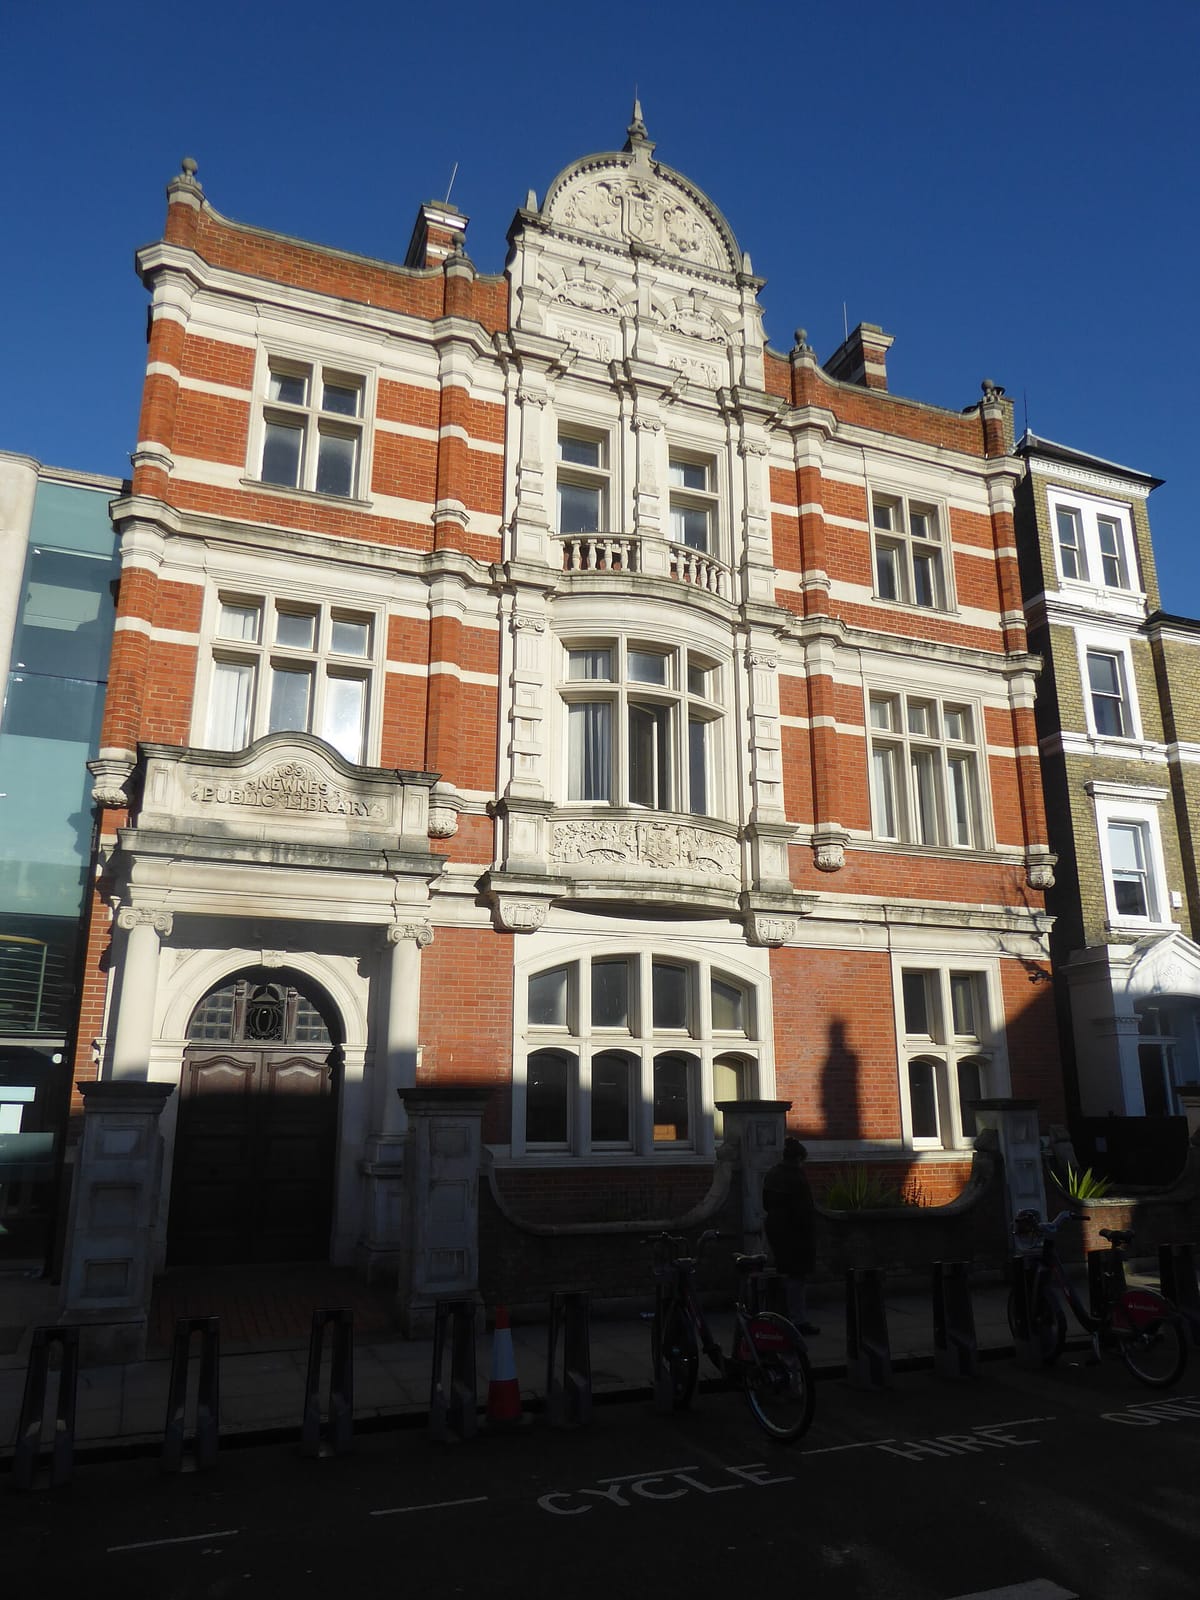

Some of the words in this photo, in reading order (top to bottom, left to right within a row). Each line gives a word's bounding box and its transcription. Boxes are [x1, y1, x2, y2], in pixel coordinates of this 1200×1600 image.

[201, 786, 276, 808] PUBLIC
[284, 793, 375, 817] LIBRARY
[257, 777, 329, 795] NEWNES
[536, 1462, 797, 1517] CYCLE
[873, 1427, 1042, 1462] HIRE
